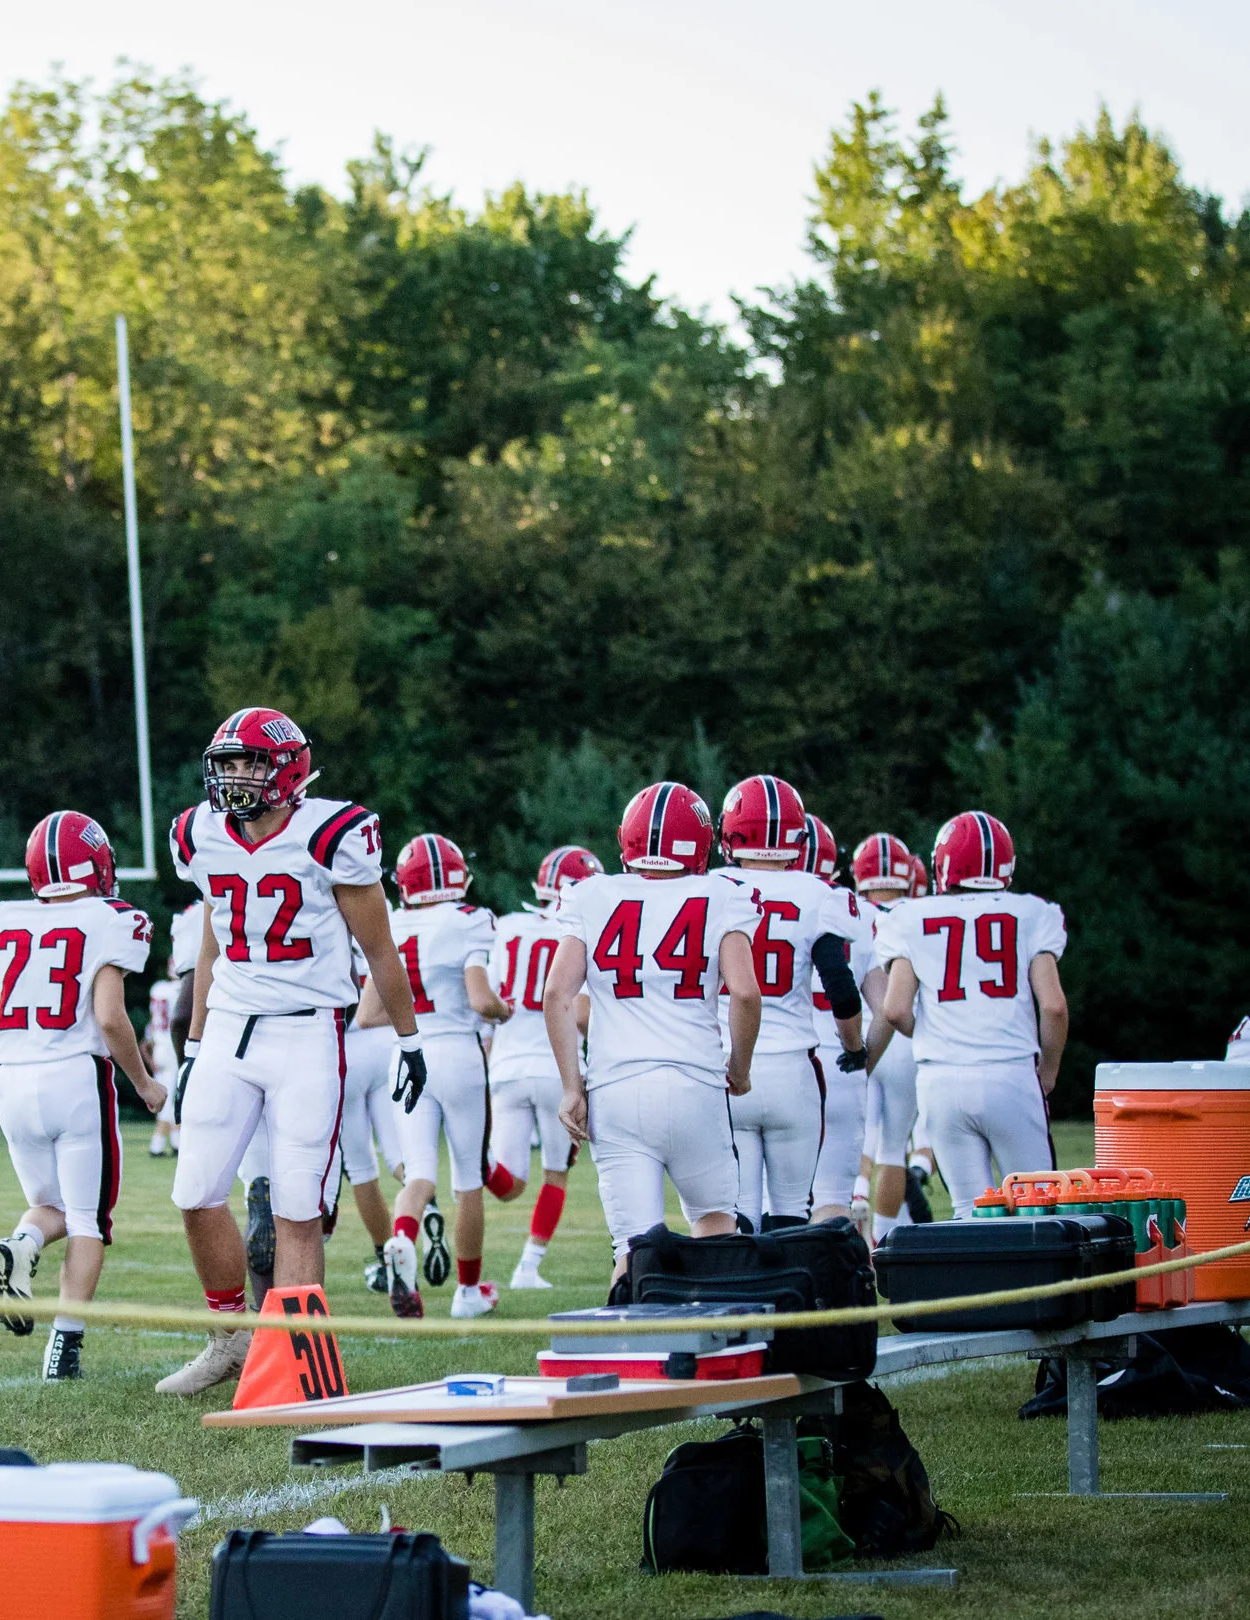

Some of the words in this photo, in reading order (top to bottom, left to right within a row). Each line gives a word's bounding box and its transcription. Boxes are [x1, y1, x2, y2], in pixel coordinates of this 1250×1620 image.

[420, 889, 457, 903] Riddell
[641, 858, 669, 867] Riddell
[207, 873, 313, 963] 72
[592, 896, 710, 1001] 44
[922, 912, 1018, 1003] 79
[500, 935, 560, 1011] 10
[48, 1333, 65, 1376] ARMOUR
[281, 1292, 345, 1402] 50
